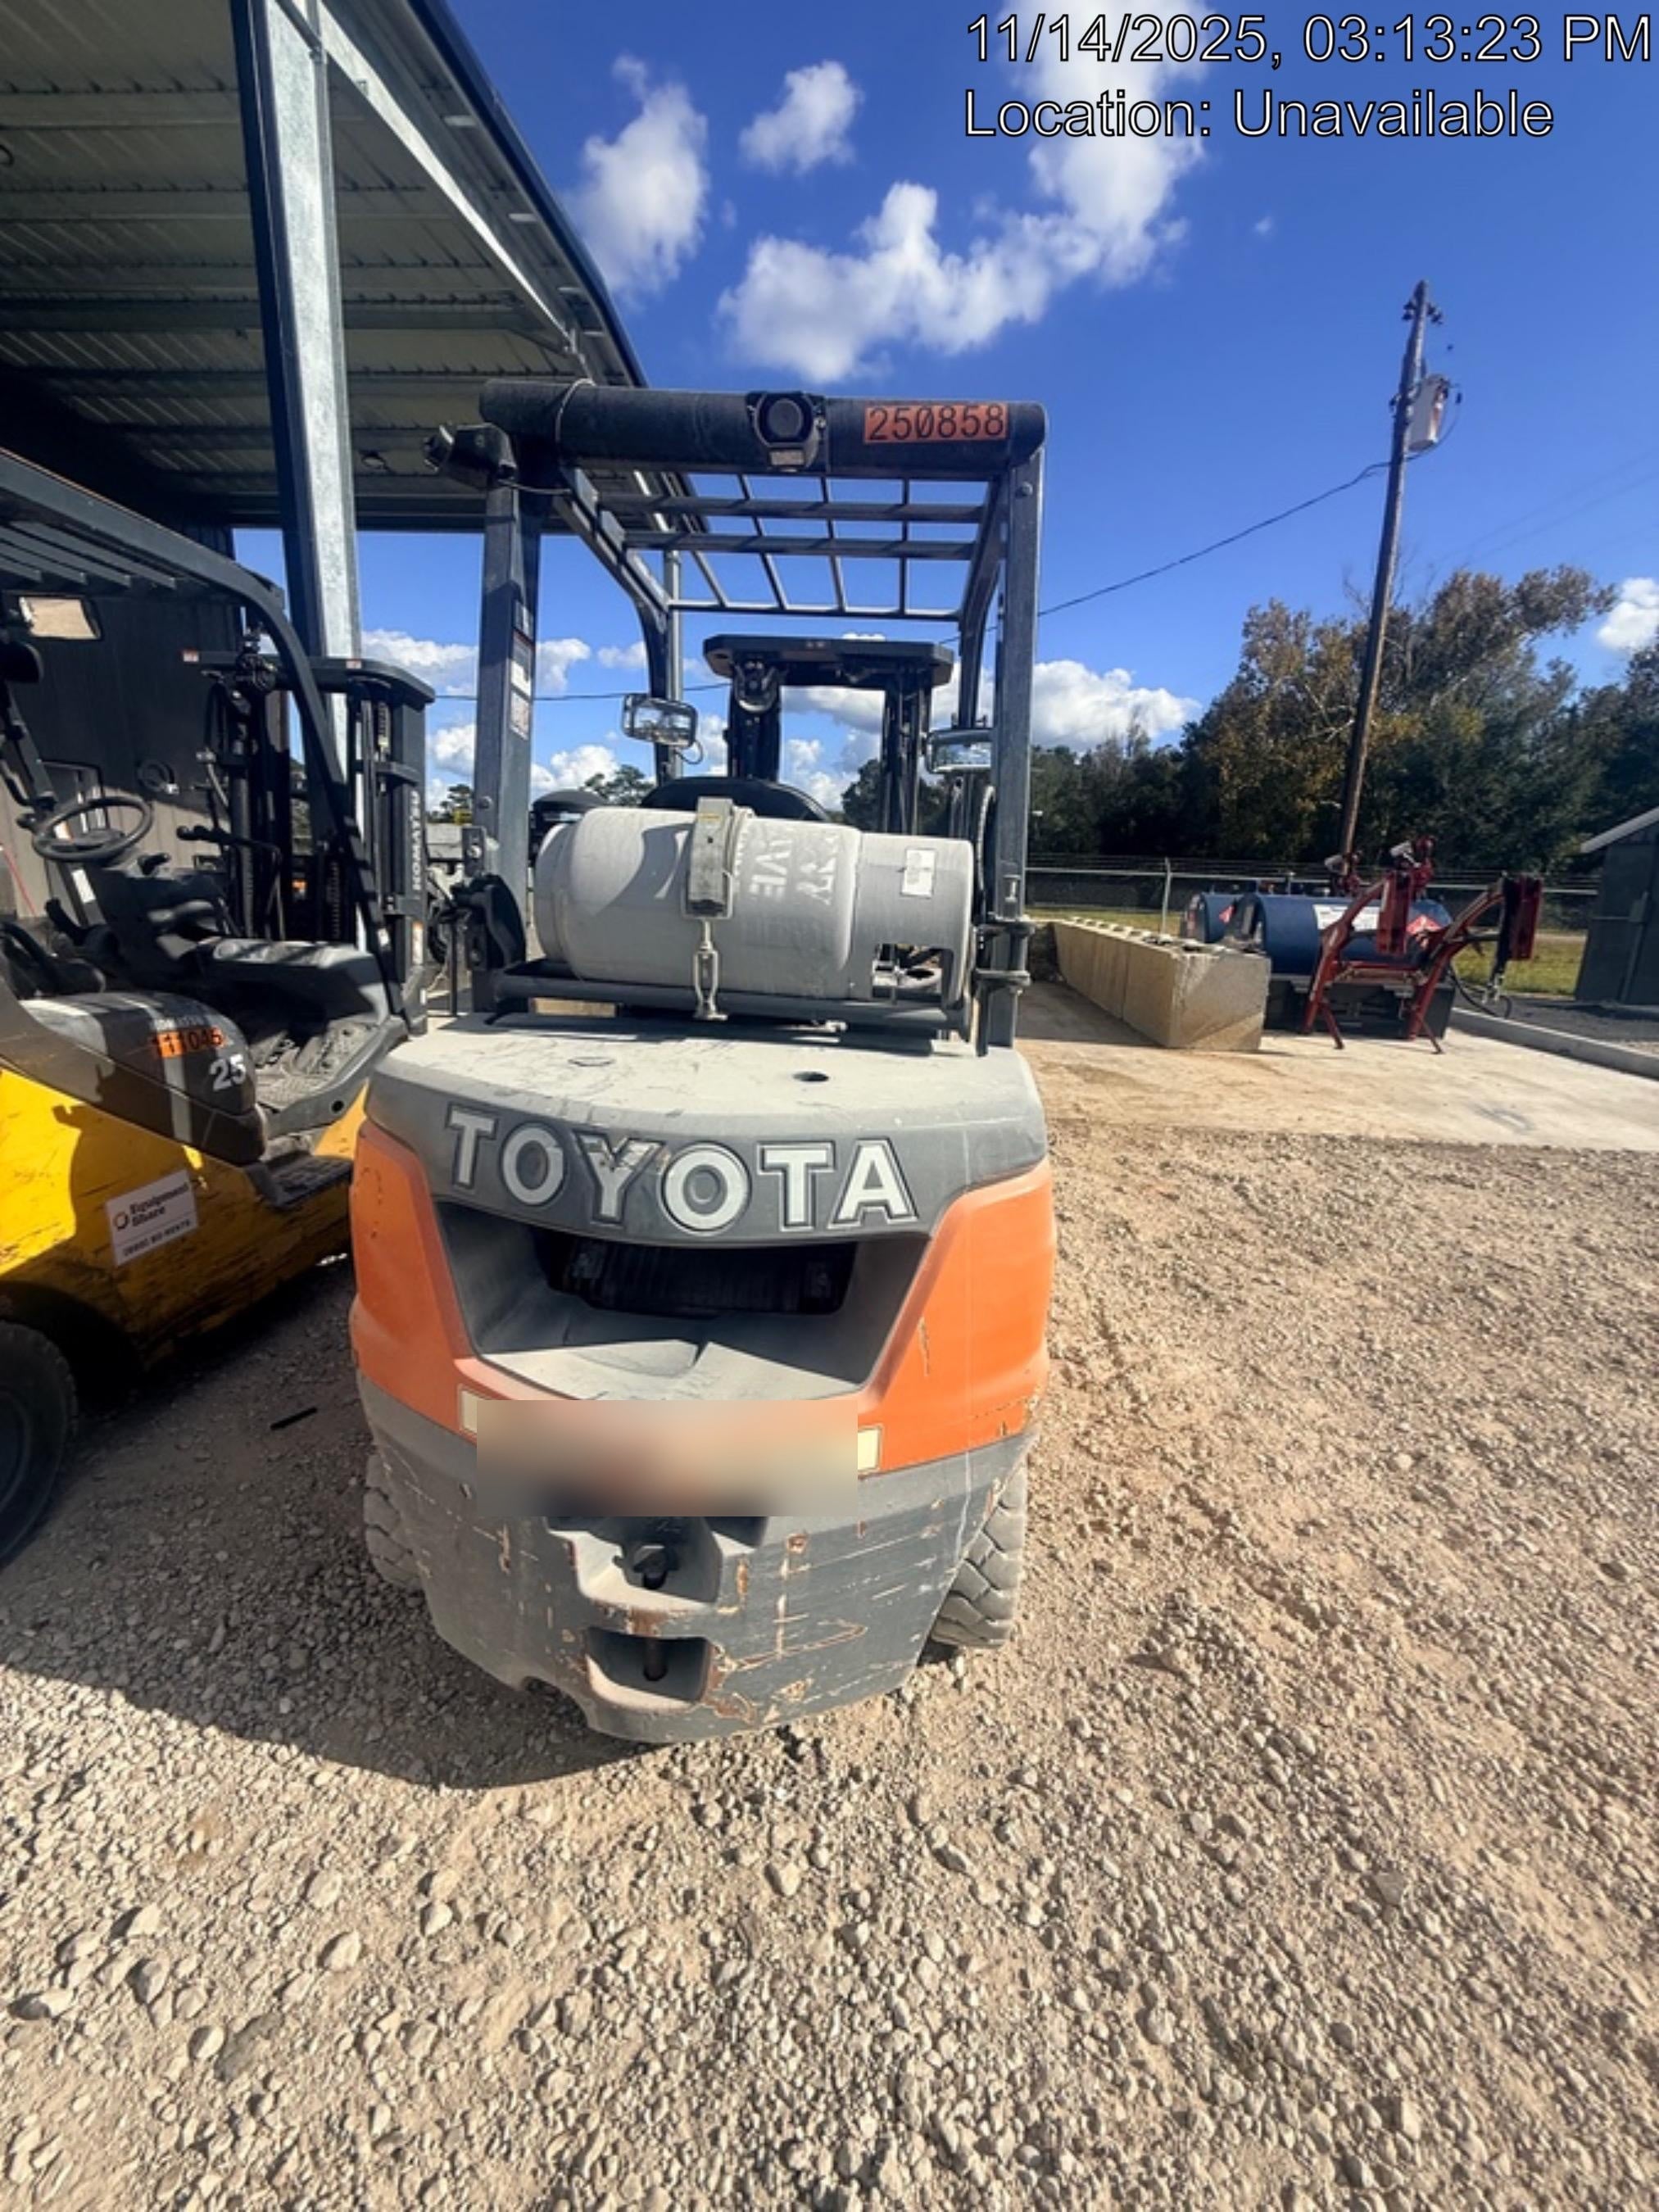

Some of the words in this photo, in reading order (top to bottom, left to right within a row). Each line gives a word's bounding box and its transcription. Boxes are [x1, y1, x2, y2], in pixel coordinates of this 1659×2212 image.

[868, 404, 1004, 441] 250858
[209, 1054, 247, 1092] 25
[446, 1104, 920, 1235] TOYOTA
